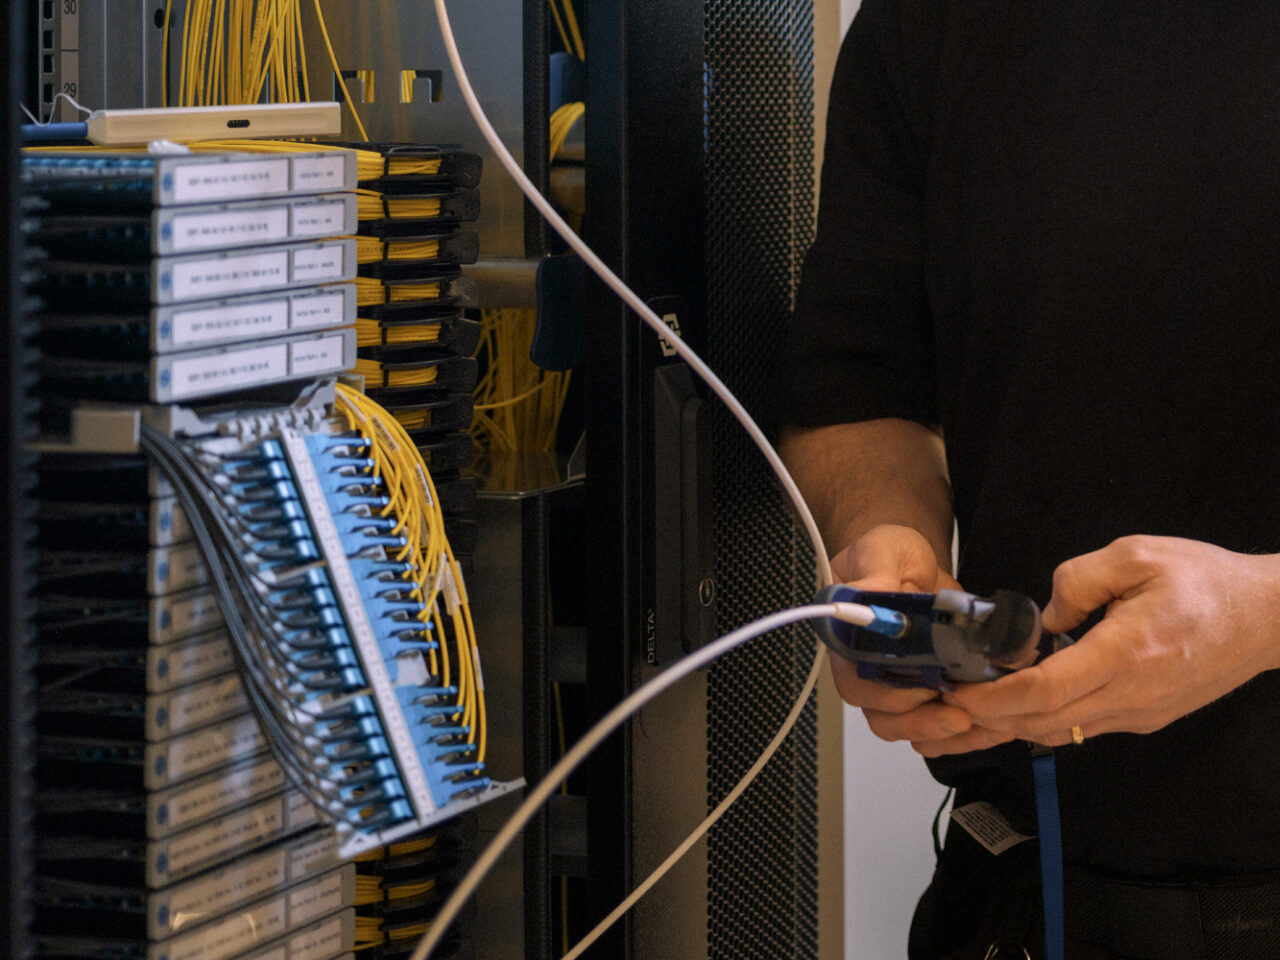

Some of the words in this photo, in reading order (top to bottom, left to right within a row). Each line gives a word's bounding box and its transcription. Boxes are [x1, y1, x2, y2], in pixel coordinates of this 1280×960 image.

[63, 0, 77, 15] 30
[63, 82, 77, 98] 29
[647, 612, 655, 664] DELTA
